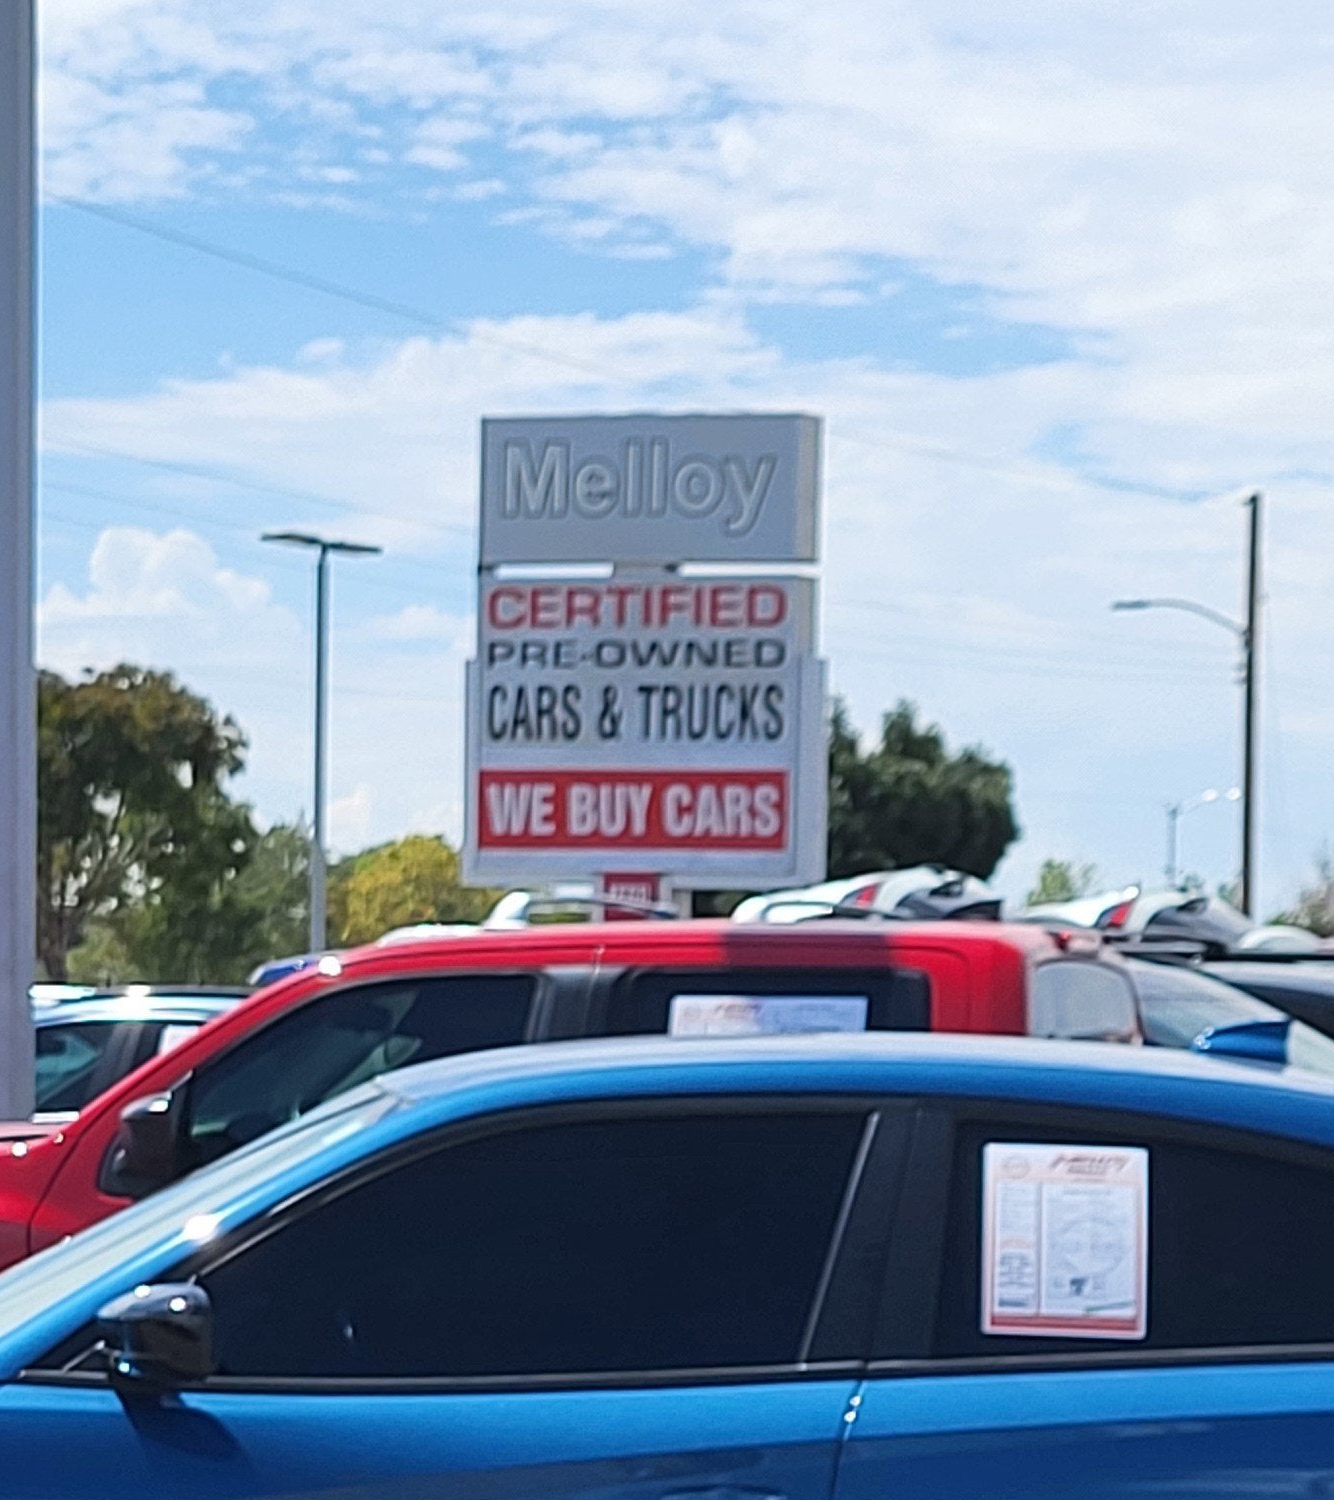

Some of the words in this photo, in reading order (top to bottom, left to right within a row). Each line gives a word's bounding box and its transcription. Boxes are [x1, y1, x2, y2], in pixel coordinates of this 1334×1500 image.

[499, 437, 778, 537] Melloy
[488, 585, 788, 630] CERTIFIED
[487, 638, 786, 669] PRE-OWNED
[487, 684, 581, 742] CARS
[598, 685, 622, 740] &
[637, 683, 784, 741] TRUCKS
[486, 783, 556, 837] WE
[570, 783, 653, 837] BUY
[662, 783, 781, 838] CARS
